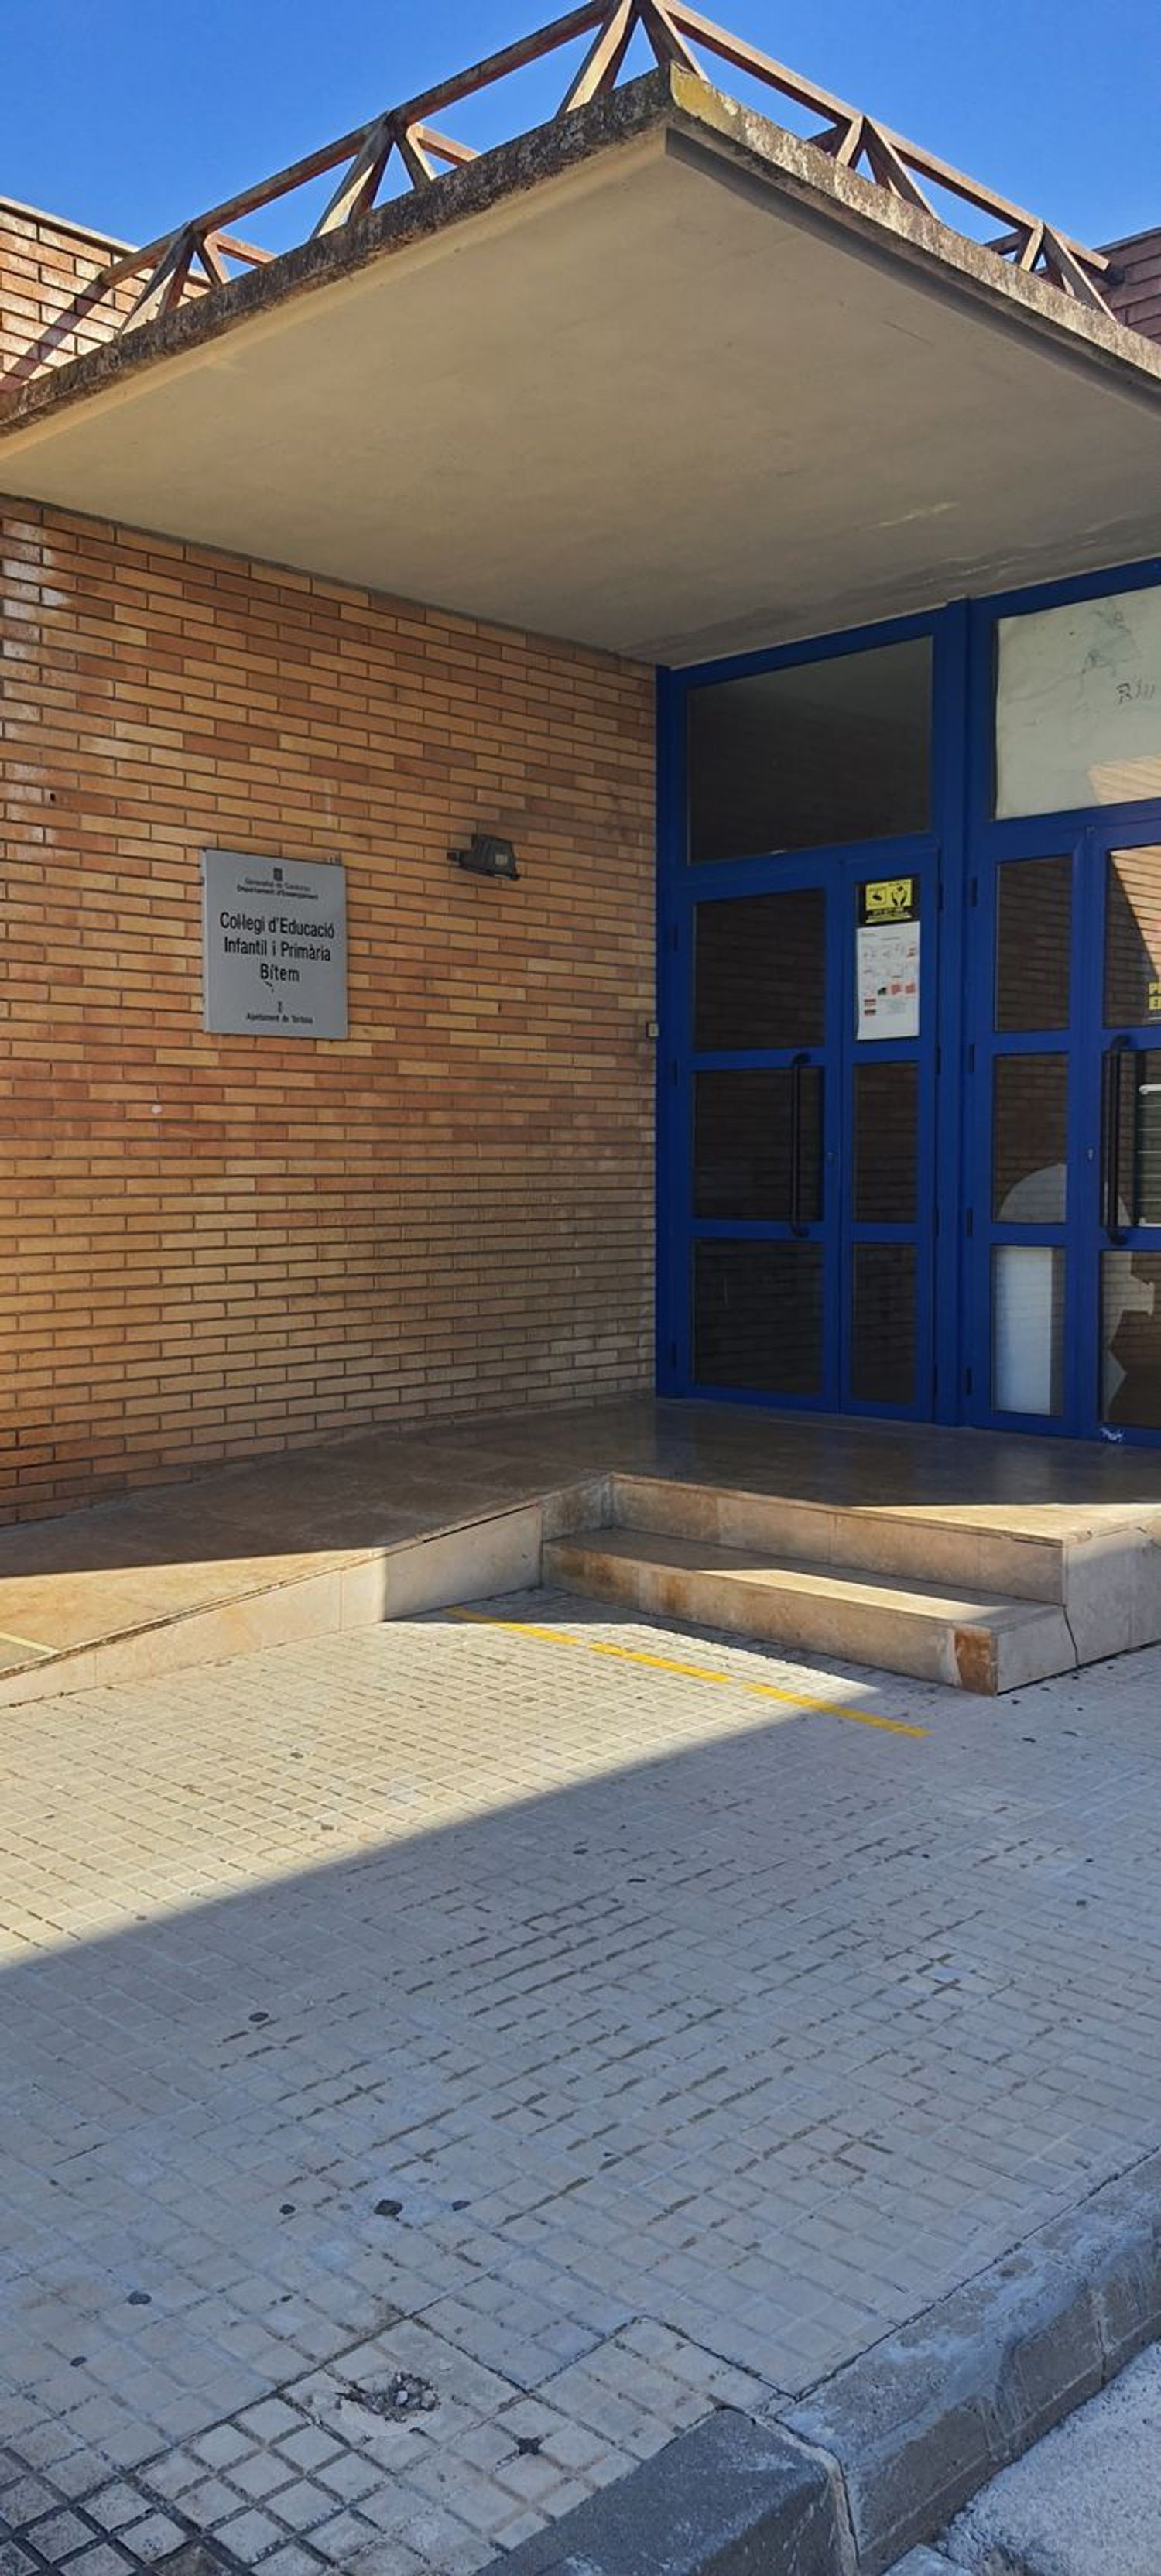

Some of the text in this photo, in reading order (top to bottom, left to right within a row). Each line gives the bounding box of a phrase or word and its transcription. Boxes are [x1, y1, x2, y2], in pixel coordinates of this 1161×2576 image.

[237, 884, 275, 895] Departament
[268, 916, 335, 939] d'Educació
[224, 937, 331, 961] Infantil i Primària
[282, 1014, 289, 1023] de
